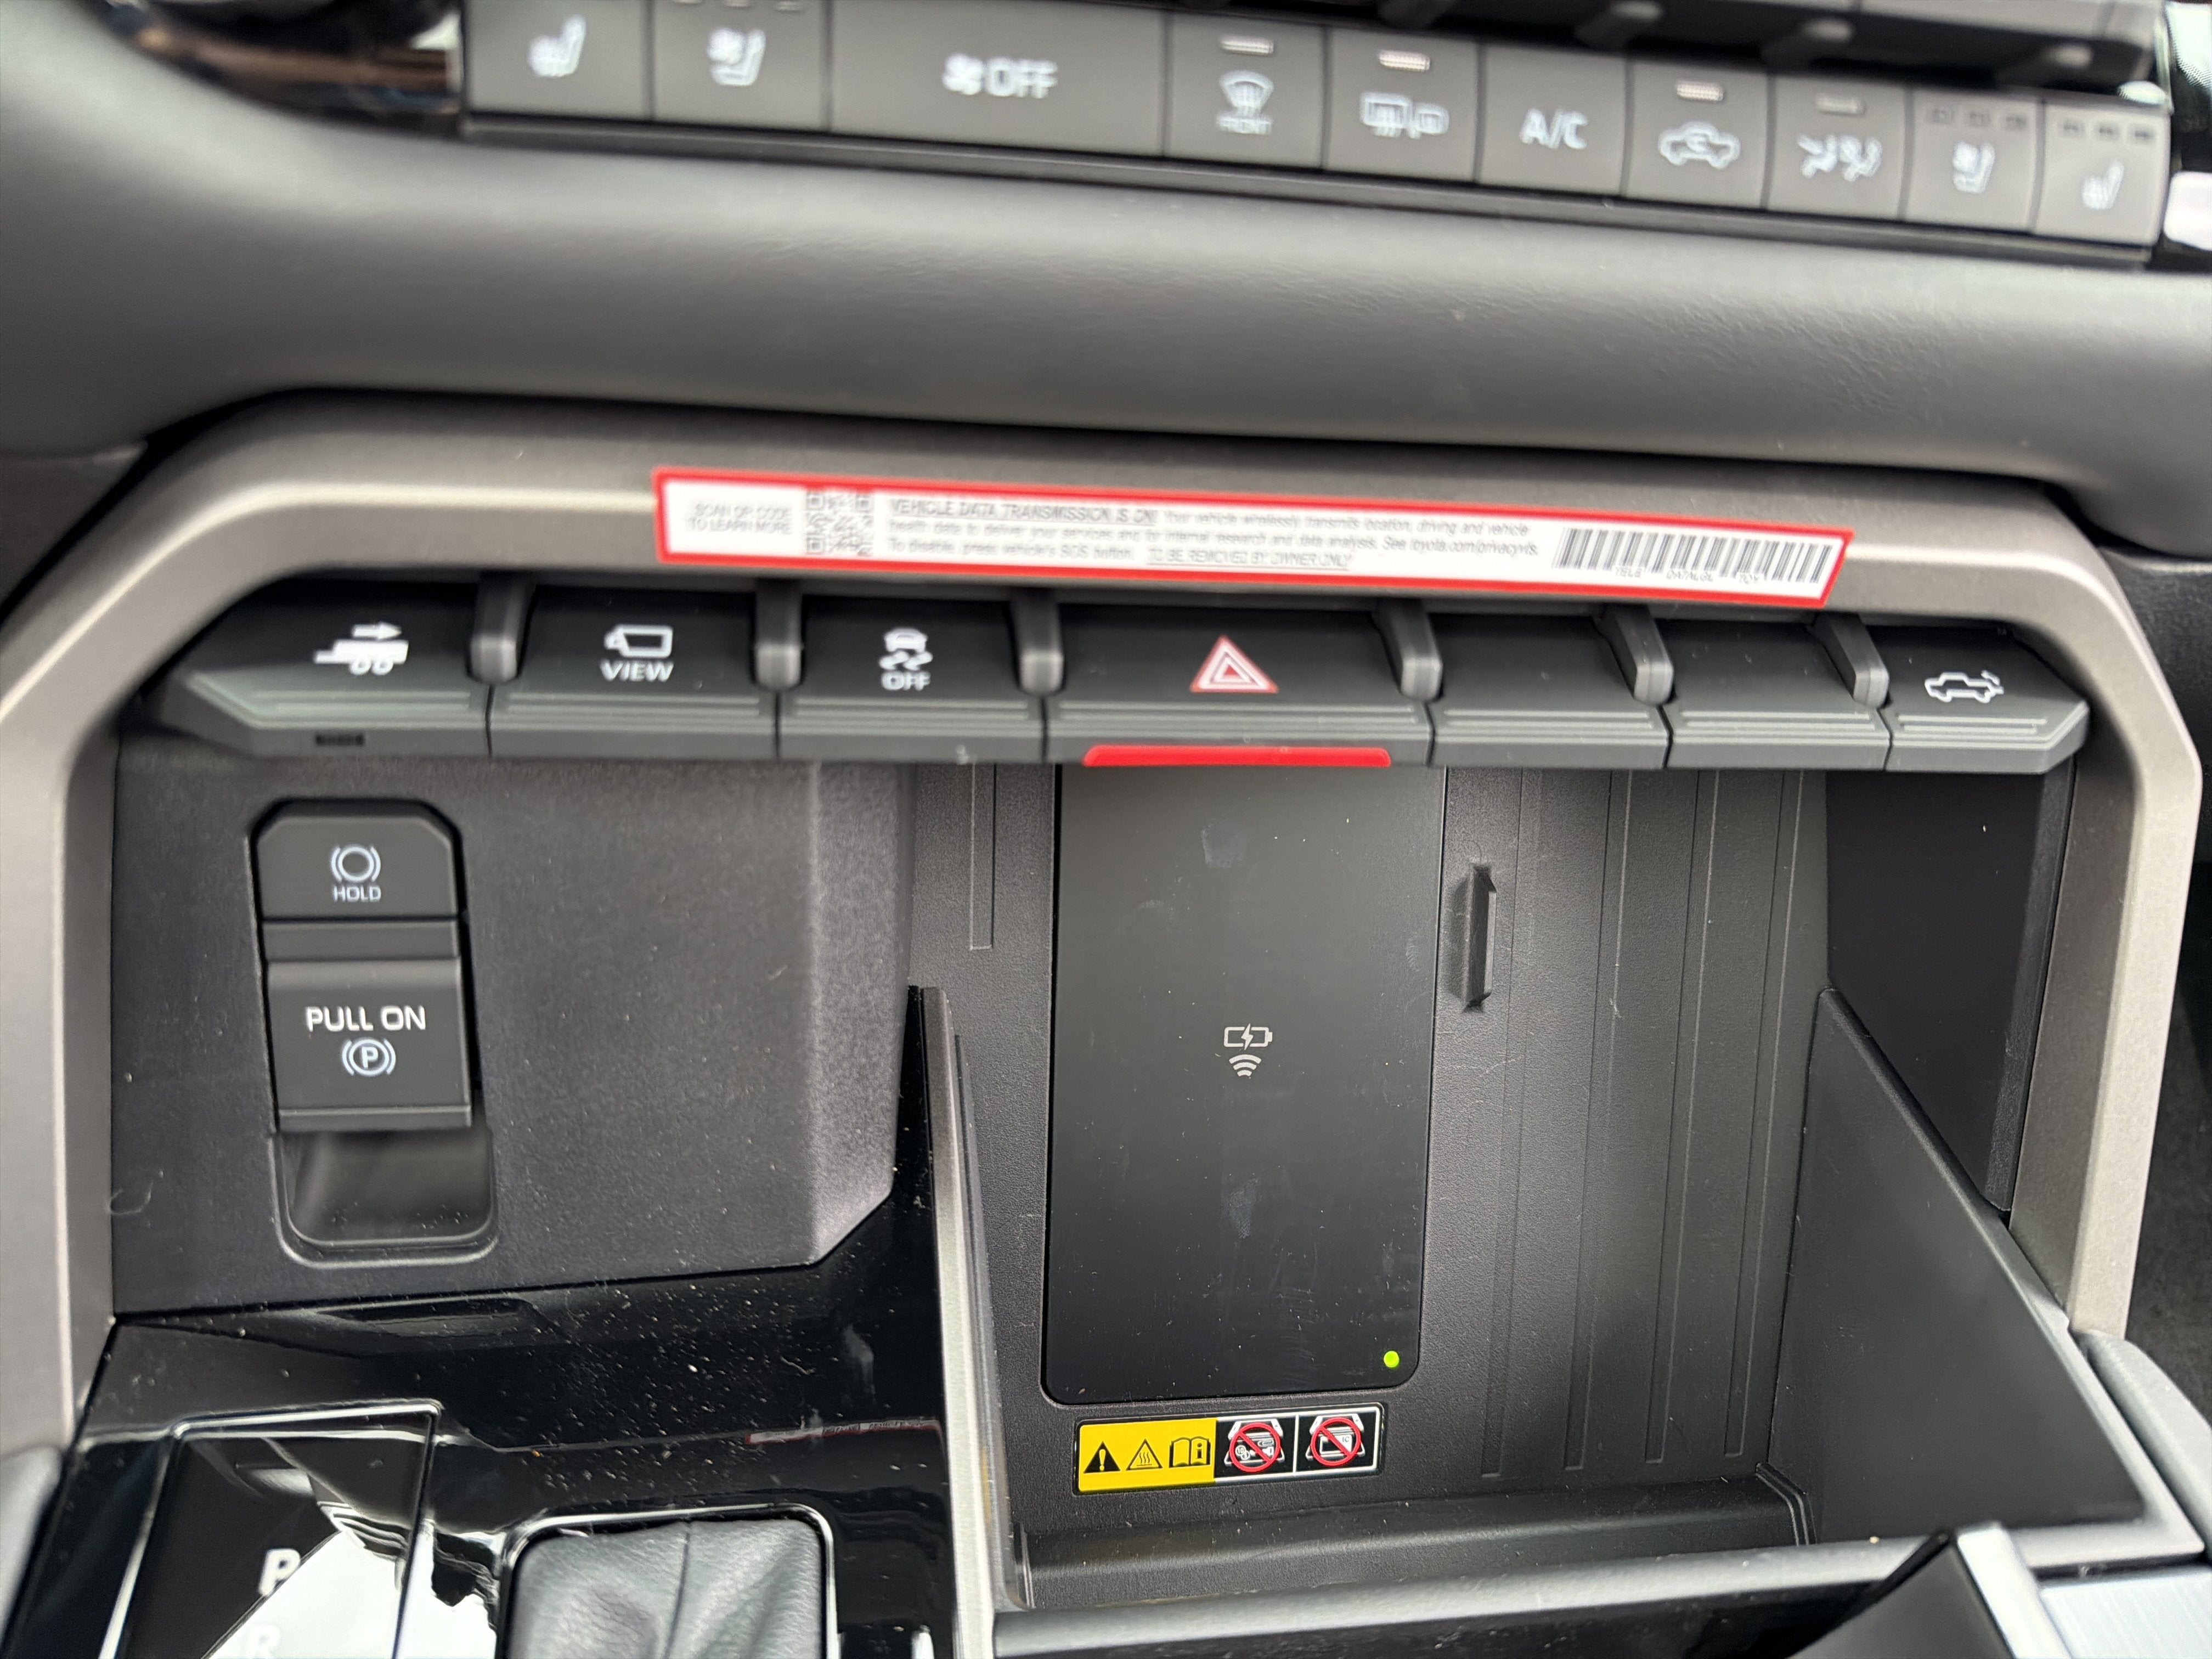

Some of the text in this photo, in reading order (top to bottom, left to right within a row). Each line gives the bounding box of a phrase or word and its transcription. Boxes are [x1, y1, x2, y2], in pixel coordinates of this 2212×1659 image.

[986, 57, 1058, 98] OFF
[1521, 109, 1588, 150] A/C
[693, 503, 731, 517] SCAN
[756, 506, 792, 520] CODE
[891, 498, 955, 516] VEHICLE
[958, 500, 994, 517] DATA
[1000, 502, 1110, 521] TRANSMISSION
[1116, 507, 1128, 523] IS
[1196, 512, 1237, 526] vehicle
[1244, 513, 1300, 529] wirelessly
[1304, 516, 1360, 531] transmits
[1417, 519, 1457, 537] driving
[1461, 522, 1485, 535] and
[1488, 522, 1531, 537] vehicle
[687, 517, 792, 535] TO LEARN MORE
[888, 519, 928, 534] health
[934, 521, 961, 535] data
[966, 522, 980, 536] to
[1062, 528, 1114, 541] services
[1117, 529, 1141, 542] and
[1166, 531, 1210, 545] internal
[1215, 533, 1266, 546] research
[1271, 534, 1293, 548] and
[1298, 535, 1323, 548] data
[1383, 535, 1406, 551] See
[888, 537, 905, 552] To
[962, 543, 997, 556] press
[1060, 544, 1089, 559] SOS
[1147, 548, 1163, 562] TO
[1167, 549, 1183, 562] BE
[1188, 549, 1248, 565] REMOVED
[1251, 551, 1267, 566] BY
[1270, 552, 1317, 567] OWNER
[1318, 553, 1352, 568] ONLY
[600, 660, 674, 682] VIEW
[881, 670, 931, 691] OFF
[332, 885, 381, 902] HOLD
[306, 1005, 426, 1032] PULL ON
[360, 1046, 379, 1069] P
[258, 1548, 301, 1596] P
